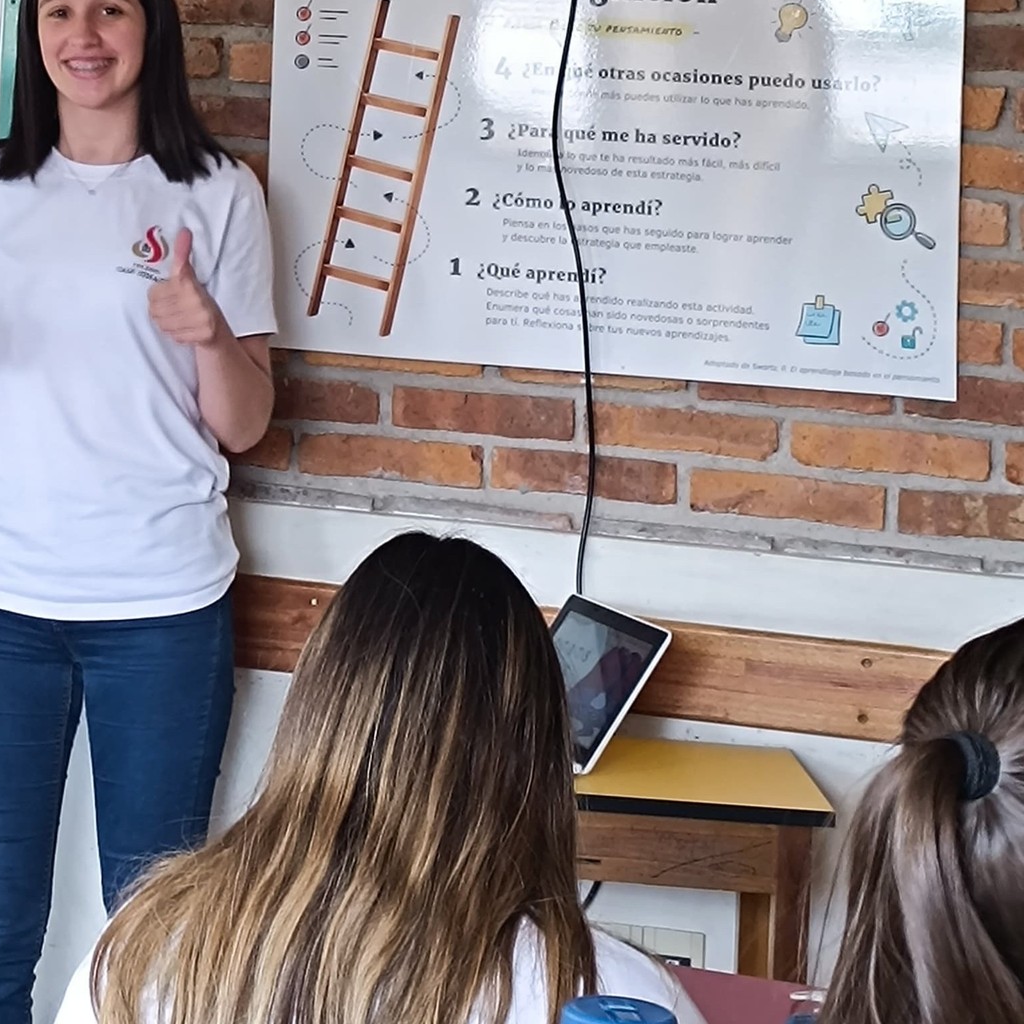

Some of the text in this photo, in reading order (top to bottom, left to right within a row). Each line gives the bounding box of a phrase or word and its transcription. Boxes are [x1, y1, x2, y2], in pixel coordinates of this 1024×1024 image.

[605, 24, 683, 37] PENSAMIENTO
[494, 57, 512, 80] 4
[522, 62, 555, 78] ¿En
[598, 66, 646, 81] otras
[651, 67, 743, 86] ocasiones
[749, 73, 805, 91] puedo
[811, 76, 881, 92] usarlo?
[600, 90, 621, 101] más
[624, 91, 660, 104] puedes
[663, 93, 698, 104] utilizar
[700, 95, 710, 105] lo
[713, 97, 732, 107] que
[735, 98, 753, 107] has
[755, 100, 810, 110] aprendido.
[479, 117, 742, 148] 3 ¿Par qué me ha servido?
[516, 164, 523, 173] y
[525, 163, 535, 172] lo
[561, 165, 608, 176] novedoso
[611, 167, 623, 177] de
[626, 169, 648, 179] esta
[650, 170, 703, 183] estrategia.
[567, 151, 576, 160] lo
[579, 153, 597, 162] que
[600, 153, 609, 162] te
[612, 153, 625, 163] ha
[628, 154, 675, 165] resultado
[678, 157, 699, 167] más
[702, 157, 726, 169] fácil,
[729, 160, 750, 171] más
[753, 161, 780, 172] difícil
[465, 188, 481, 206] 2
[492, 192, 553, 209] ¿Cómo
[581, 199, 663, 216] aprendí?
[502, 218, 793, 246] Piensa en los asos que has seguido para lograr aprender
[502, 233, 699, 255] y descubre la strategia que empleaste.
[449, 257, 606, 283] 1 ¿Qué aprendí?
[486, 288, 755, 315] Describe qué has arendido realizando esta actividad.
[486, 301, 530, 313] Enumera
[532, 304, 551, 315] qué
[553, 307, 582, 316] cosas
[606, 310, 627, 320] sido
[630, 313, 684, 325] novedosas
[687, 317, 694, 325] o
[696, 317, 770, 331] sorprendentes
[485, 317, 508, 327] para
[523, 318, 574, 330] Reflexiona
[577, 321, 605, 332] sbre
[608, 325, 623, 335] tus
[626, 327, 662, 337] nuevos
[665, 329, 731, 343] aprendizajes.
